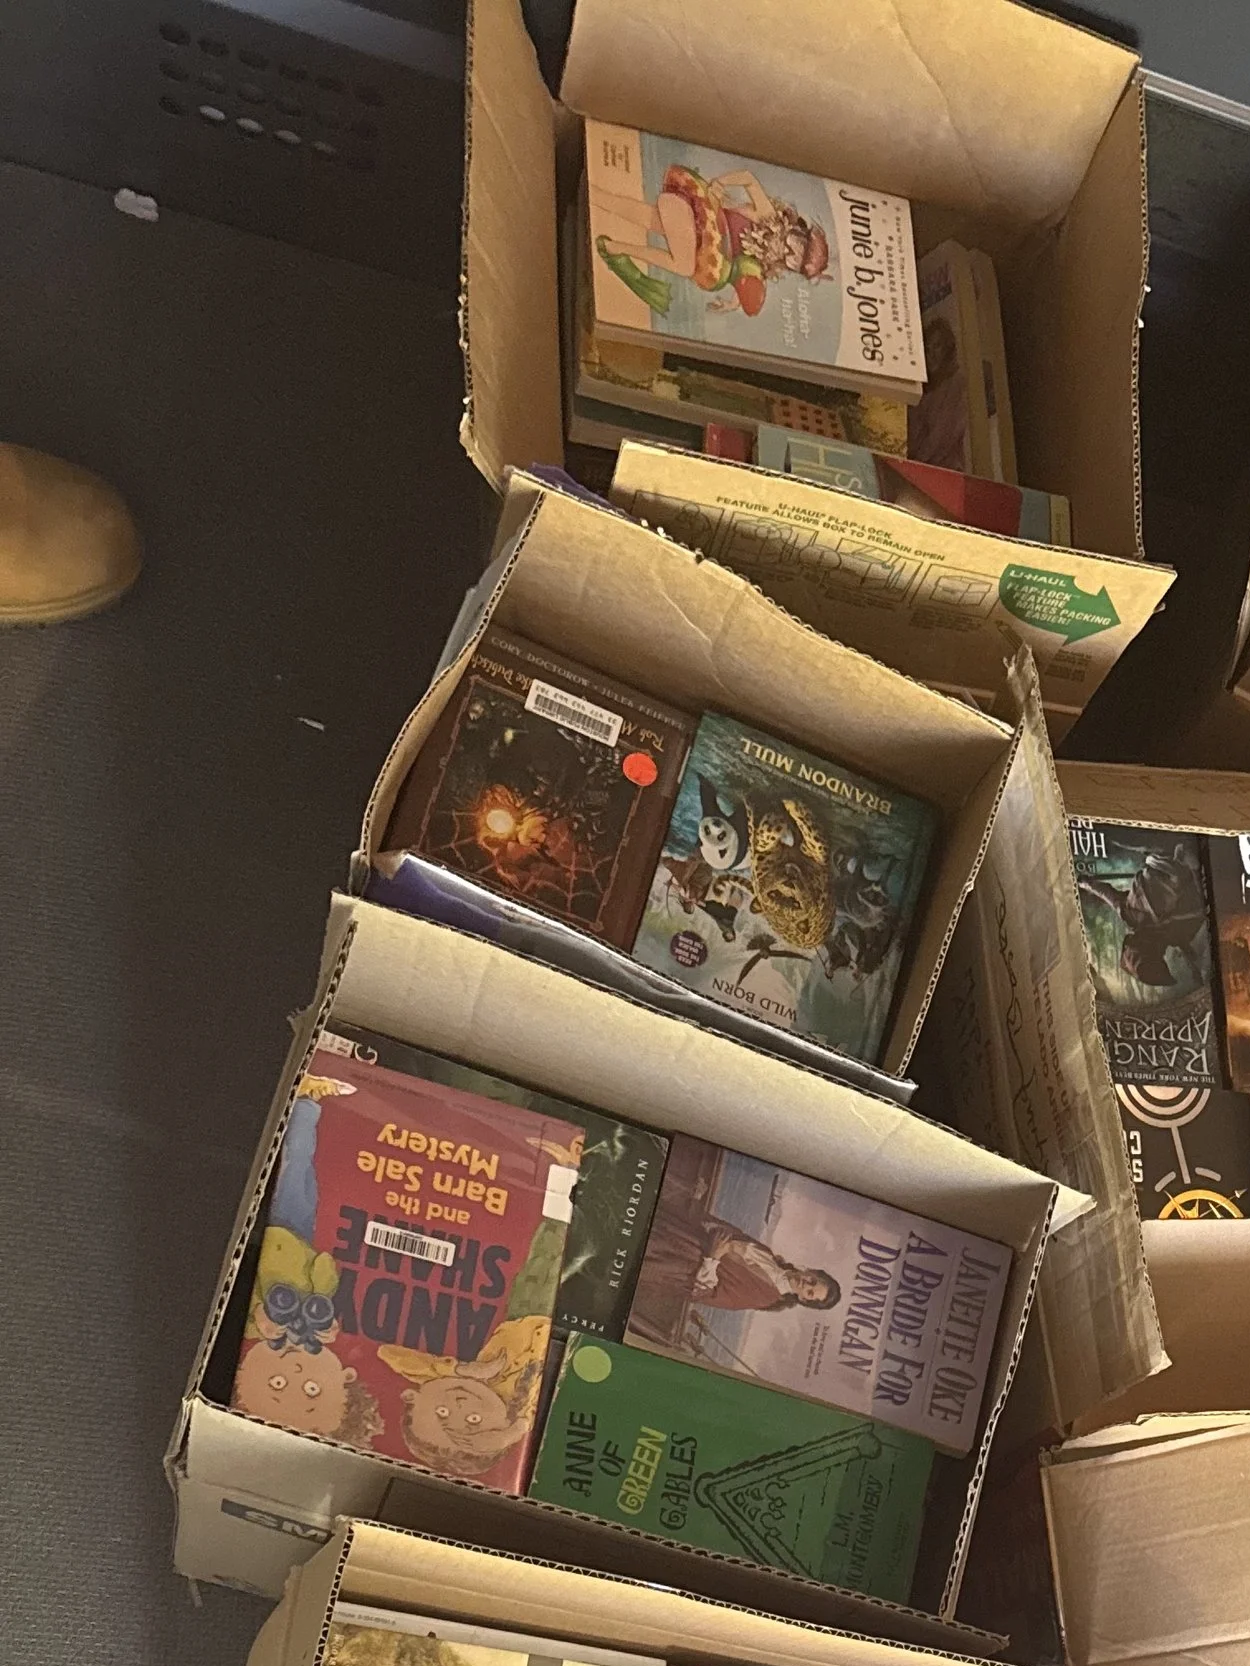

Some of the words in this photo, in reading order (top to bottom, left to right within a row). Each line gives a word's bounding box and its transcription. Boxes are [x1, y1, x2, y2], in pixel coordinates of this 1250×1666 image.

[839, 189, 877, 257] junie
[854, 262, 884, 288] b.
[846, 286, 885, 363] jones
[716, 495, 770, 514] FEATURE
[771, 508, 819, 527] ALLOWS
[821, 518, 843, 533] BOX
[844, 524, 861, 538] TO
[863, 530, 912, 552] REMAIN
[913, 546, 945, 562] OPEN
[1009, 568, 1067, 588] U-HAUL
[1059, 607, 1112, 626] PACKING
[490, 636, 522, 657] CORY
[526, 653, 590, 688] DOCTOROW
[637, 728, 665, 753] Rob
[740, 735, 796, 774] MULL
[798, 762, 894, 816] BRANDON
[711, 976, 757, 1006] BORN
[758, 995, 798, 1023] WILD
[356, 1149, 425, 1193] Sale
[376, 1122, 500, 1182] Mystery
[384, 1189, 422, 1219] the
[426, 1201, 470, 1226] and
[433, 1183, 509, 1216] Barn
[608, 1257, 627, 1290] RICK
[620, 1156, 649, 1239] RIORDAN
[908, 1231, 949, 1256] A
[331, 1270, 497, 1362] ANDY
[561, 1311, 605, 1333] PERCY
[838, 1236, 901, 1376] DONNIGAN
[880, 1258, 945, 1358] BRIDE
[939, 1245, 1000, 1365] JANETTE
[872, 1346, 924, 1408] FOR
[926, 1366, 979, 1425] OKE
[562, 1410, 597, 1497] ANNE
[598, 1440, 627, 1478] OF
[616, 1426, 668, 1516] GREEN
[658, 1432, 699, 1531] GABLES
[831, 1509, 855, 1550] L.M.
[845, 1474, 884, 1592] MONTGOMERY
